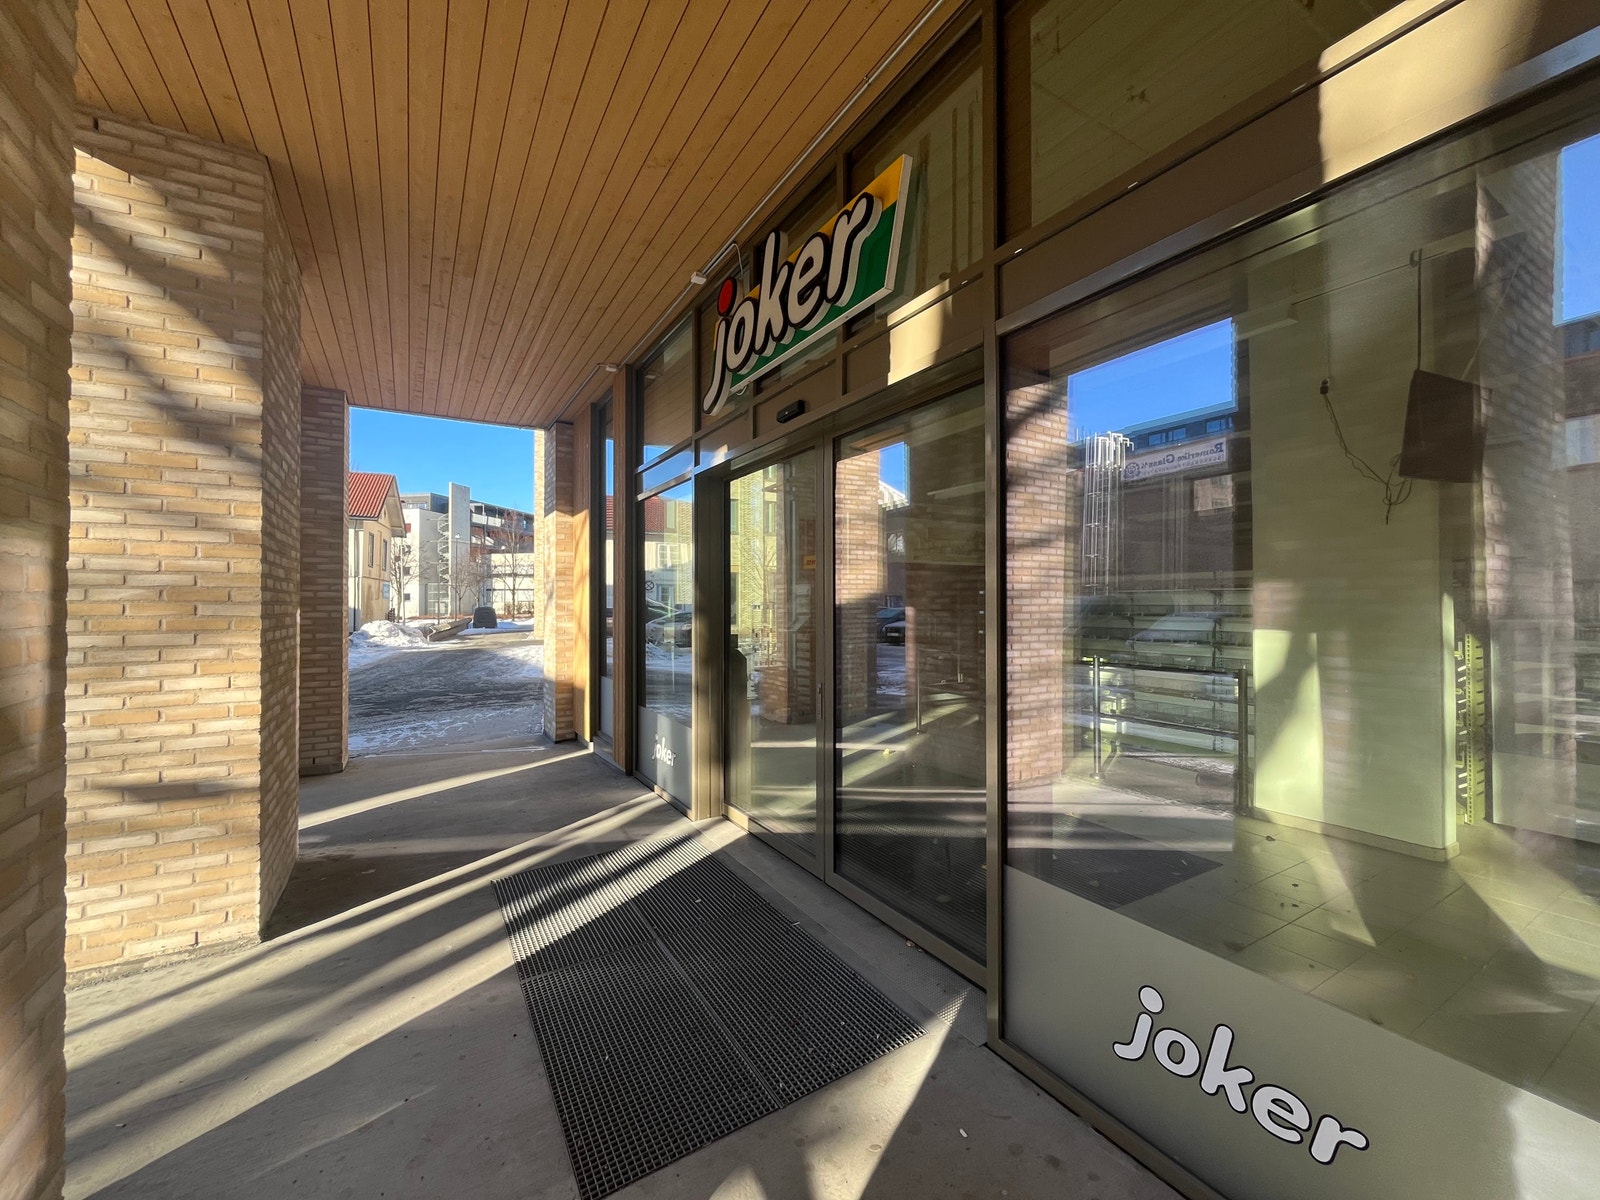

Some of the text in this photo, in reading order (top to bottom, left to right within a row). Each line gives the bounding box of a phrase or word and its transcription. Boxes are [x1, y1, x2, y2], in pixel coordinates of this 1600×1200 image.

[702, 191, 880, 415] joker
[651, 733, 677, 767] joker
[1112, 984, 1370, 1166] joker
